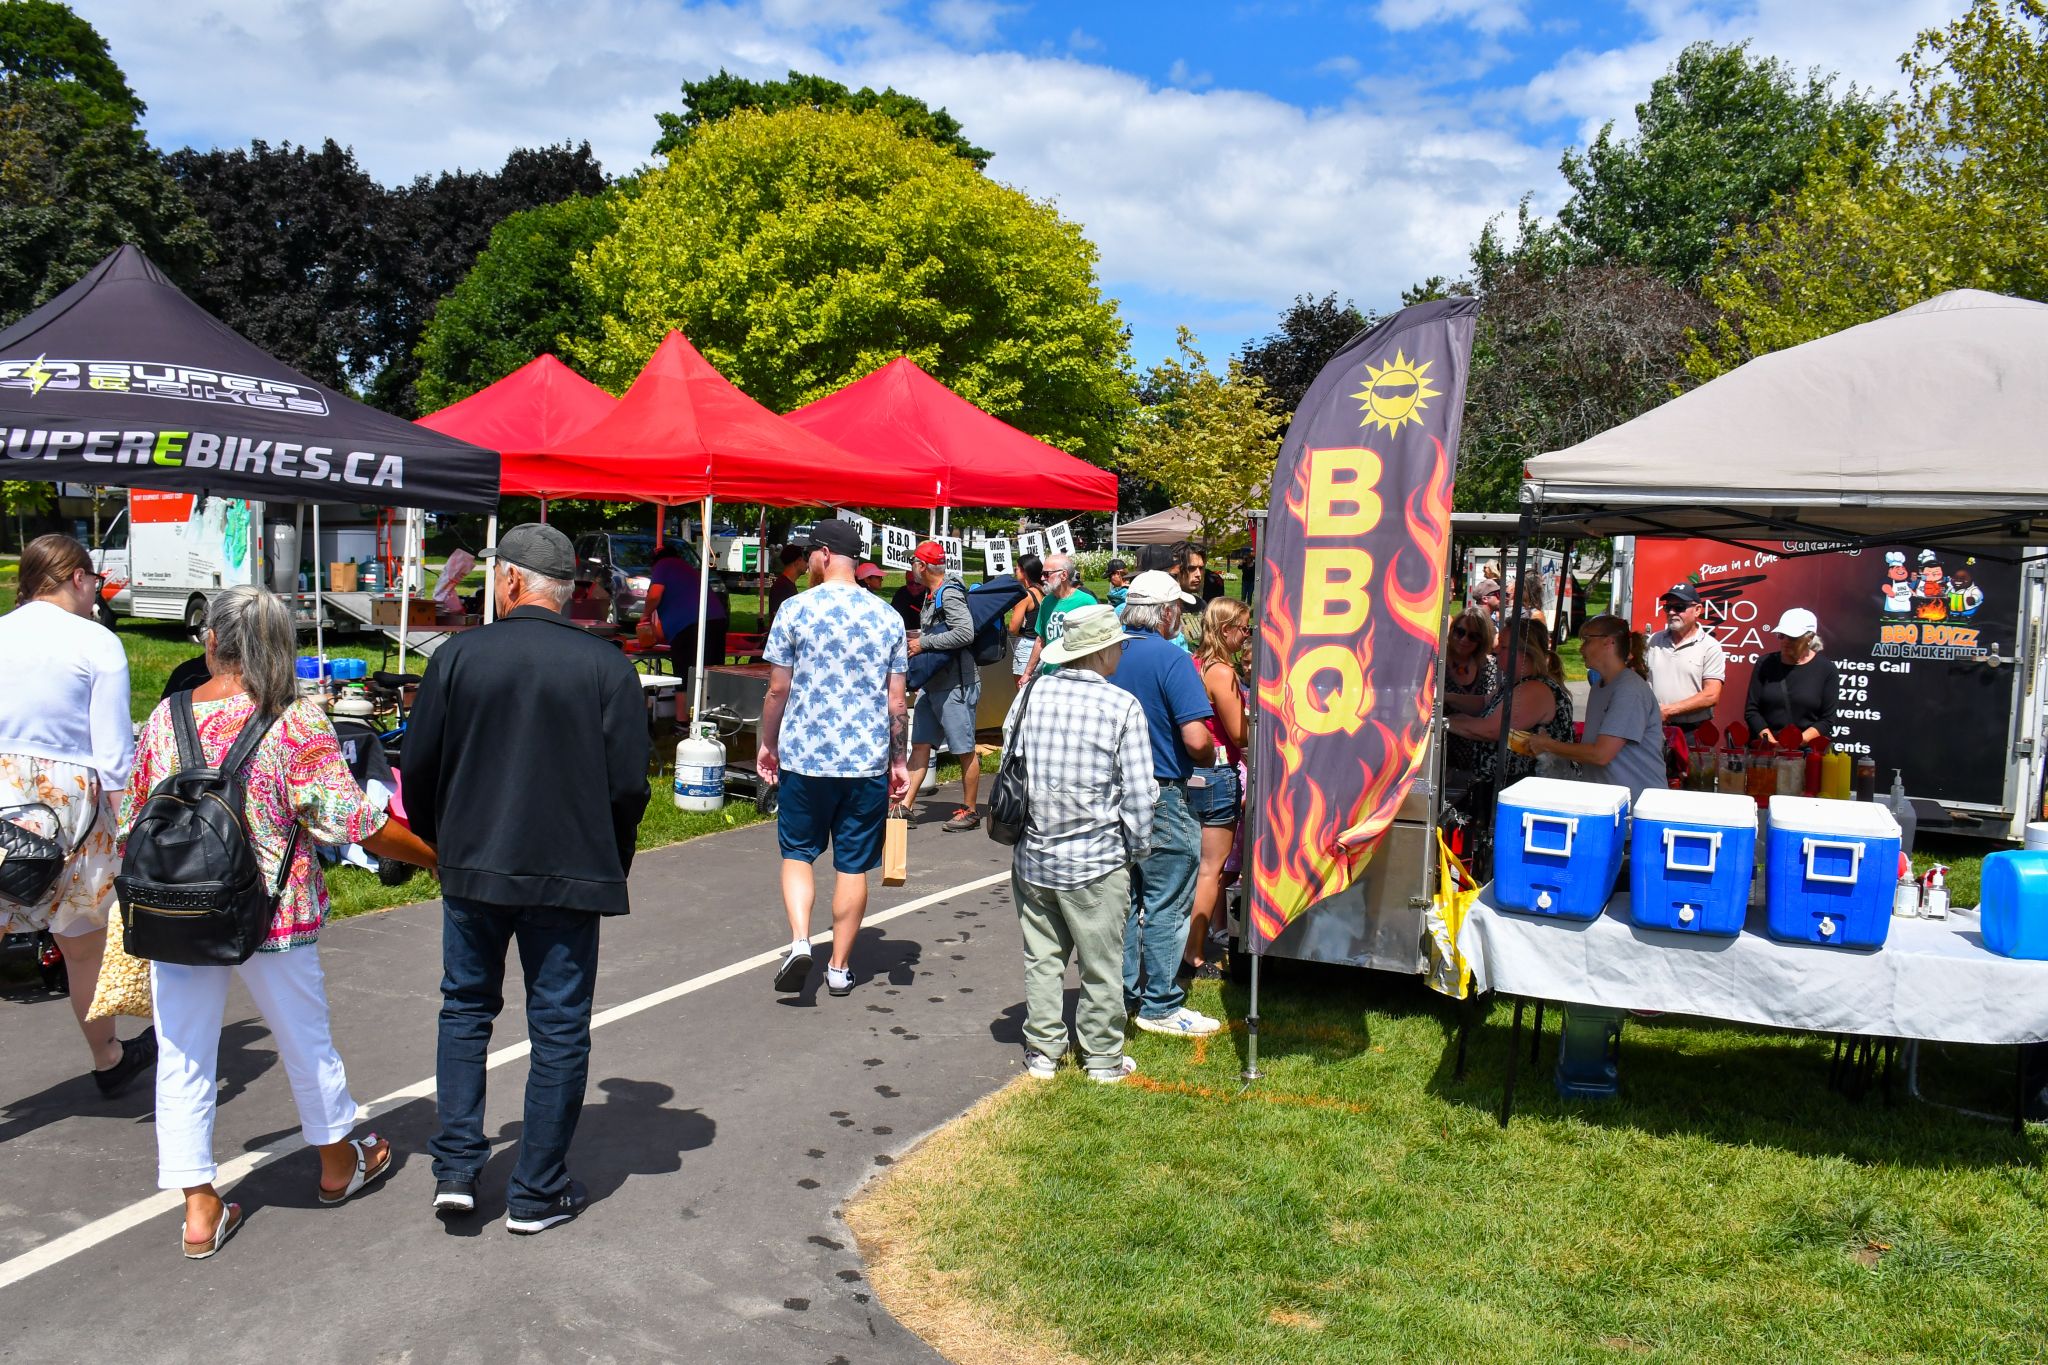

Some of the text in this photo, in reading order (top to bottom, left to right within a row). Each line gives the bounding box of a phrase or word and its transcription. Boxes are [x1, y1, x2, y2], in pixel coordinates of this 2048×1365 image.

[88, 364, 299, 396] SUPER
[0, 427, 403, 489] UPEREBIKES.CA
[1051, 525, 1066, 537] ORDER
[888, 529, 910, 550] B.B.Q
[989, 540, 1006, 550] ORDER
[1027, 535, 1036, 545] WE
[1056, 536, 1067, 547] HERE
[993, 552, 1005, 562] HERE
[1026, 545, 1038, 555] TAKE
[945, 556, 961, 570] cken
[1699, 551, 1778, 580] Pizza in a Cone
[1287, 447, 1384, 737] BBQ
[1047, 623, 1065, 640] GIV
[1881, 624, 1980, 647] BBQ BOYZZ
[1871, 643, 1987, 660] AND SMOKEHOUSE
[1832, 659, 1911, 673] vices Call
[1838, 674, 1868, 687] 719
[1838, 688, 1868, 702] 276
[1836, 708, 1881, 721] vents
[1833, 742, 1871, 754] ents
